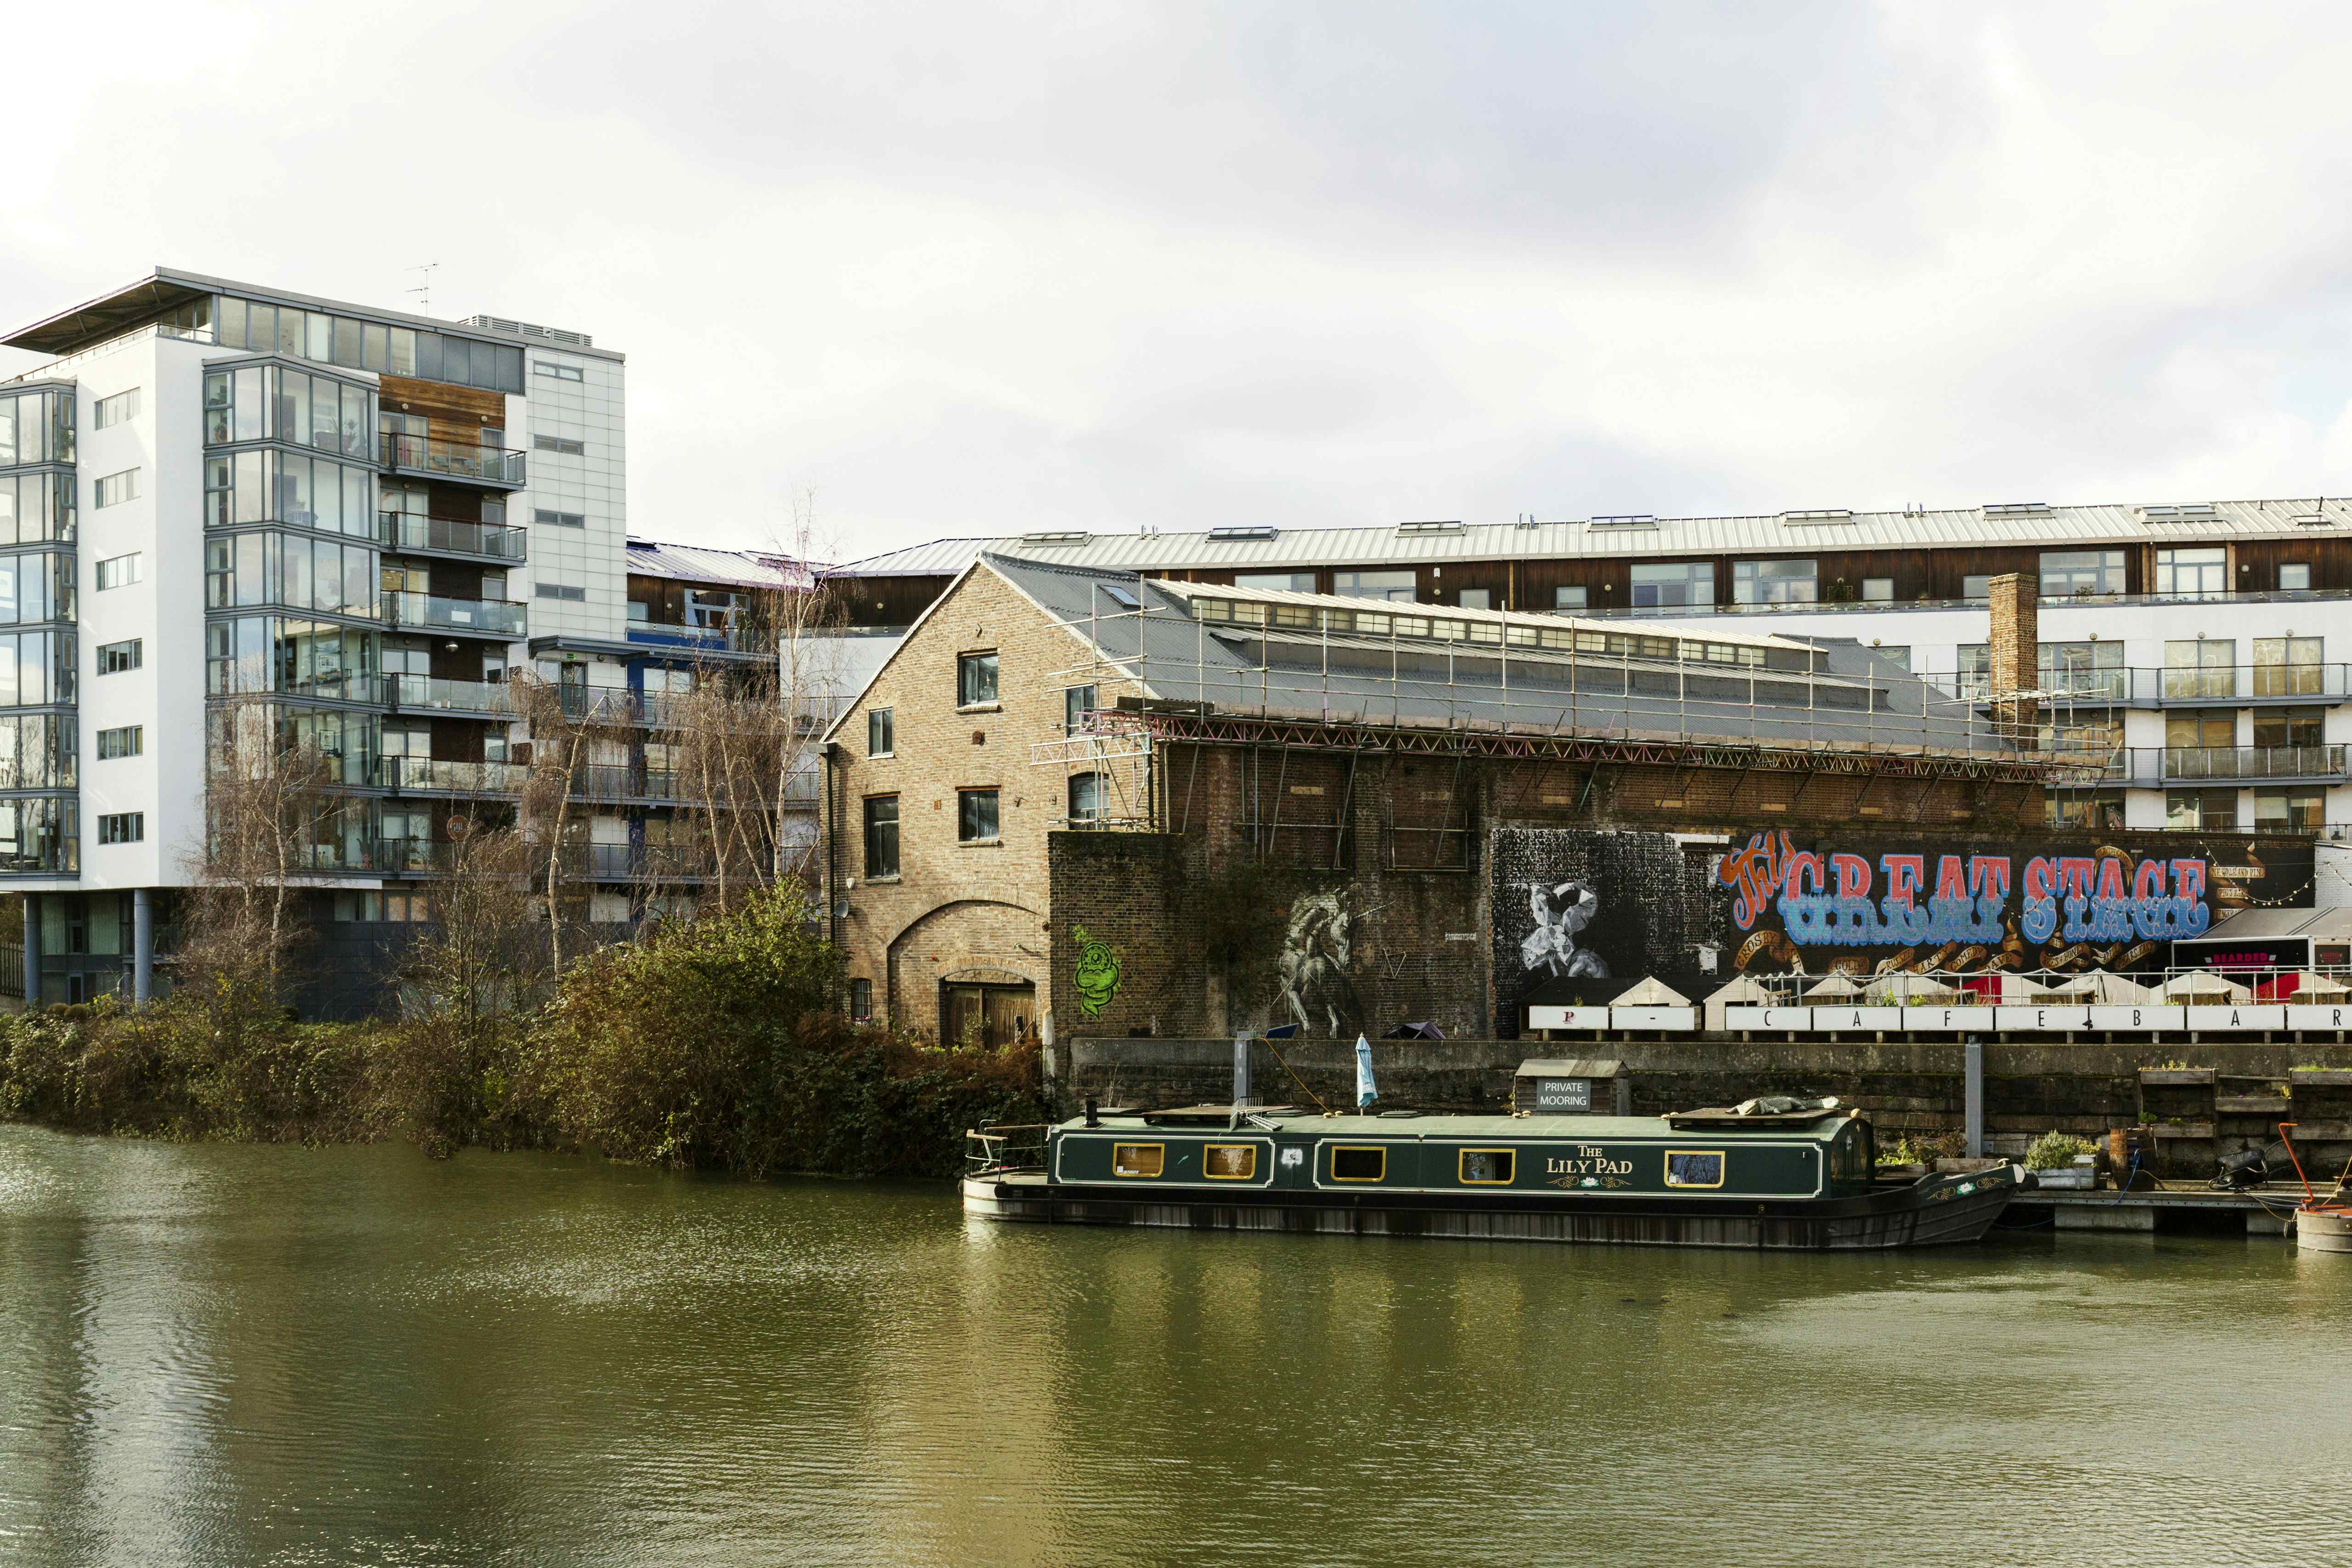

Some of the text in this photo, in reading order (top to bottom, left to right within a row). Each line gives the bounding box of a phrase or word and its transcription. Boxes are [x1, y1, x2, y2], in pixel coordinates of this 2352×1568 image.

[1777, 850, 2011, 946] GREAT
[2022, 855, 2210, 945] STAGE
[2213, 952, 2268, 963] BEARDED
[1545, 1082, 1582, 1092] PRIVATE
[1540, 1096, 1587, 1105] MOORING
